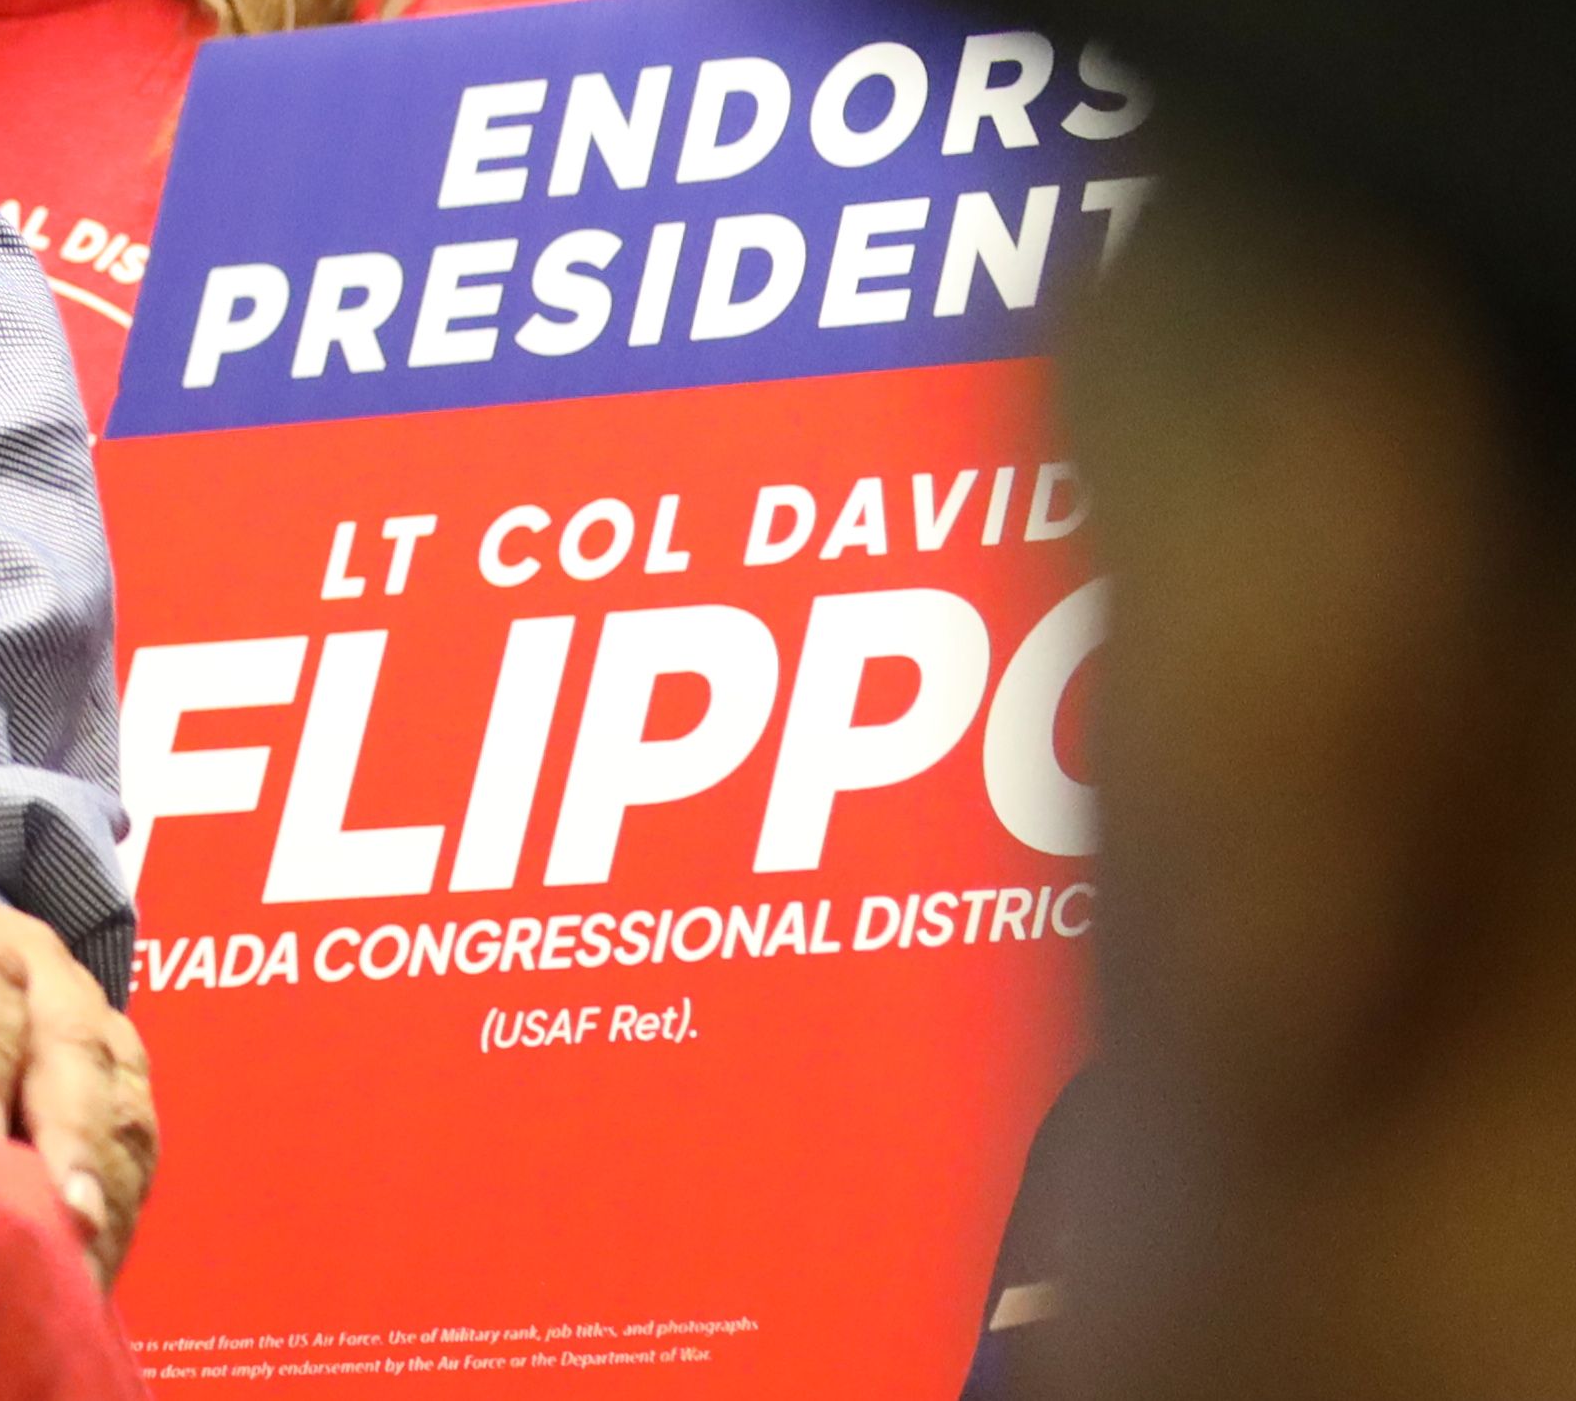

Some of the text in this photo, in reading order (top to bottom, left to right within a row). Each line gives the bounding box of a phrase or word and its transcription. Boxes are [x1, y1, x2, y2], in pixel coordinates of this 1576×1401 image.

[438, 29, 1159, 210] ENDORS
[321, 456, 1093, 600] LT COL DAVID
[311, 904, 842, 983] CONGRESSIONAL
[852, 881, 1099, 953] DISTRIC
[479, 998, 700, 1055] (USAF Ret).
[147, 1339, 158, 1352] is
[163, 1336, 214, 1352] retired
[218, 1334, 254, 1350] from
[258, 1333, 284, 1349] the
[288, 1333, 309, 1348] US
[313, 1331, 336, 1348] Air
[388, 1329, 417, 1345] Use
[420, 1328, 440, 1344] of
[440, 1326, 500, 1345] Military
[503, 1324, 541, 1342] rank,
[544, 1323, 572, 1342] job
[622, 1319, 654, 1337] and
[656, 1316, 760, 1339] photographs
[161, 1363, 197, 1379] does
[201, 1363, 227, 1378] not
[232, 1360, 275, 1380] imply
[279, 1358, 381, 1376] endorsement
[384, 1356, 405, 1376] by
[408, 1356, 434, 1373] the
[437, 1355, 461, 1372] Air
[464, 1354, 506, 1371] Force
[510, 1354, 527, 1368] or
[531, 1351, 557, 1368] the
[560, 1349, 655, 1370] Department
[660, 1346, 677, 1363] of
